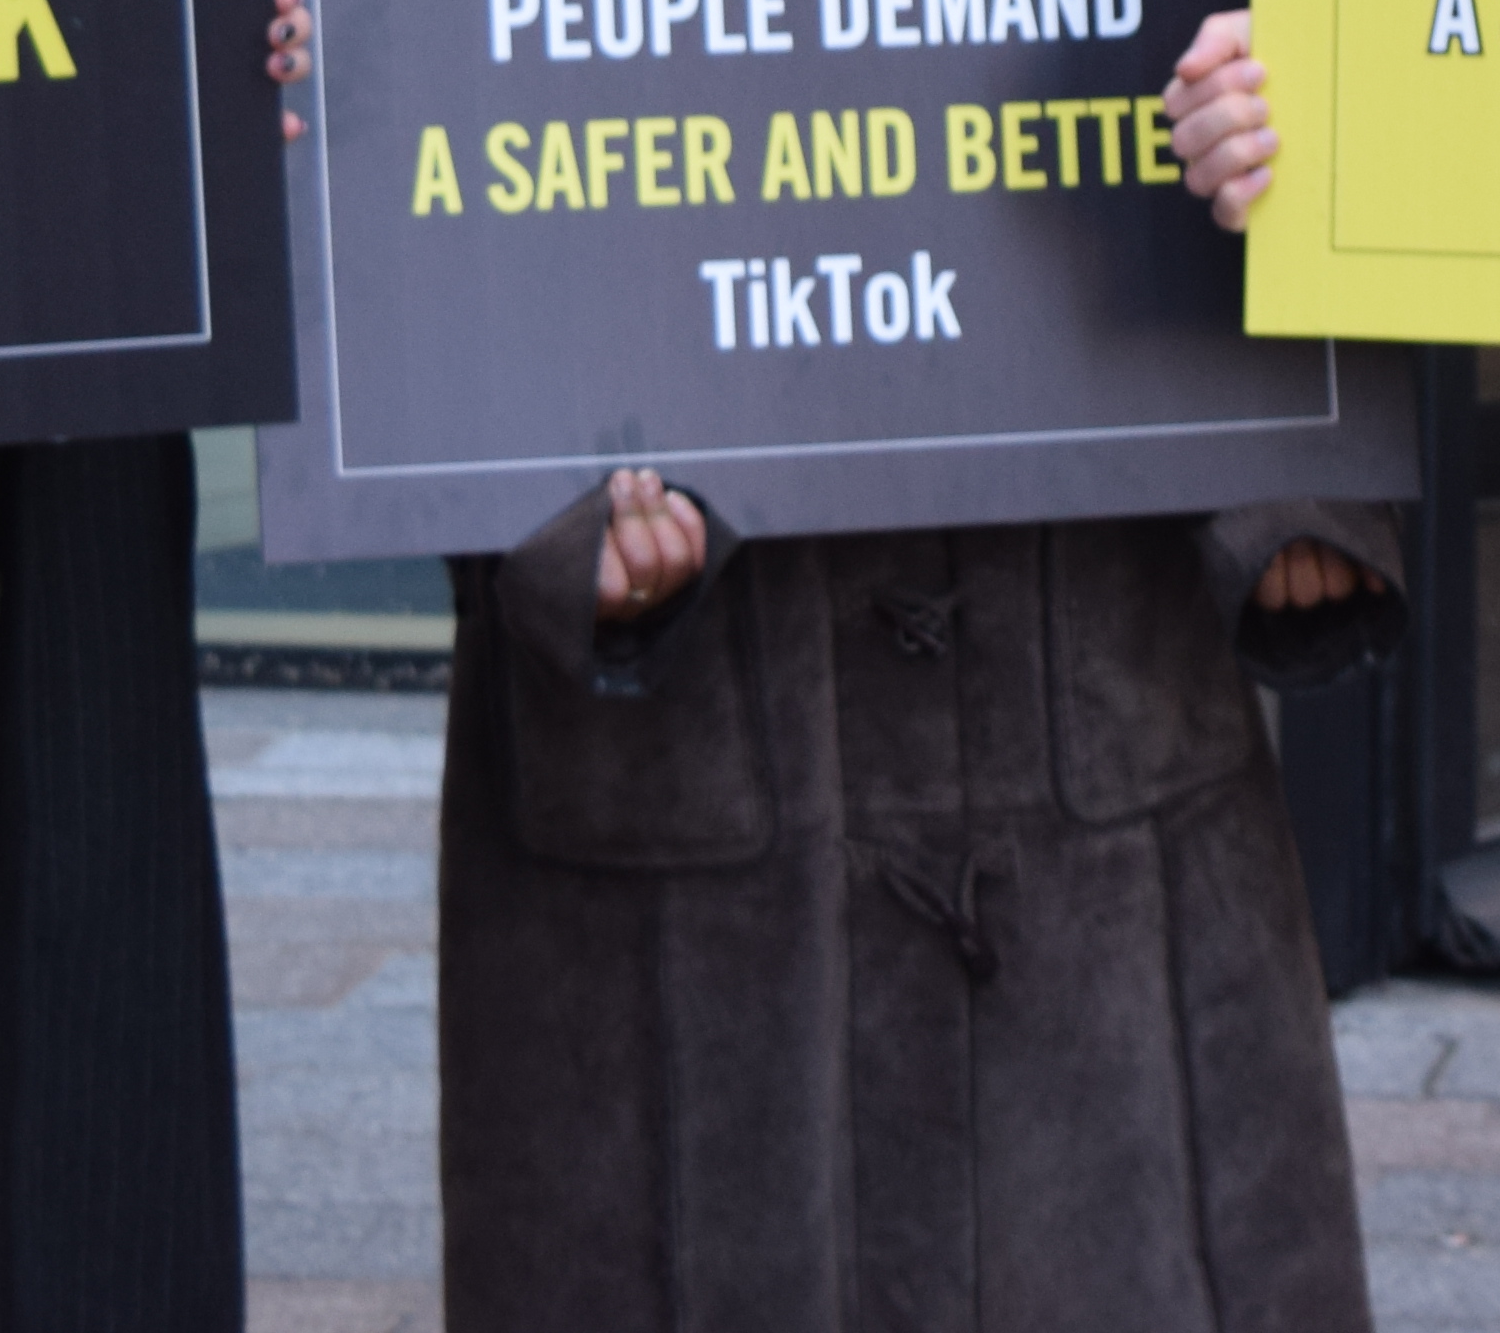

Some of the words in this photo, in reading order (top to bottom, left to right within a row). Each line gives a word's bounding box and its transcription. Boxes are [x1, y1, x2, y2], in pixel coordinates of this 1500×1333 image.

[411, 123, 464, 217] A
[485, 113, 736, 213] SAFER
[761, 106, 919, 201] AND
[945, 95, 1182, 191] BETTE
[695, 247, 965, 354] TikTok
